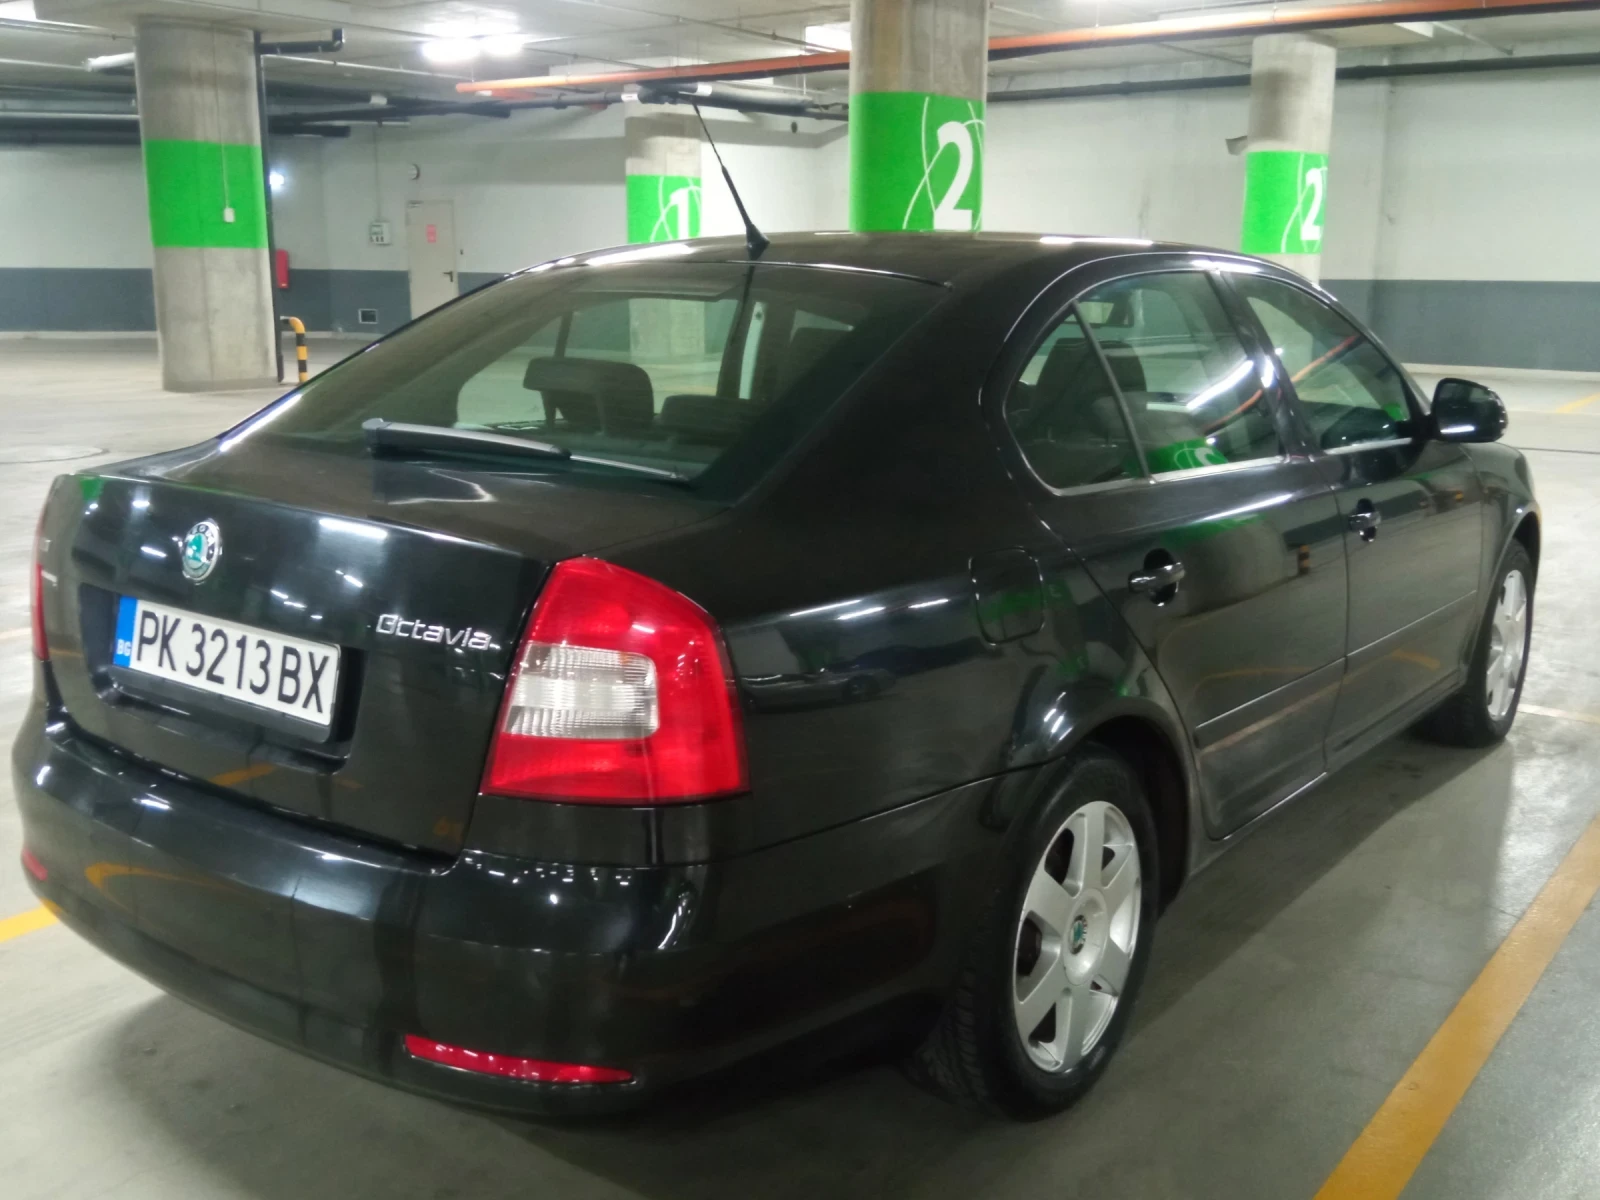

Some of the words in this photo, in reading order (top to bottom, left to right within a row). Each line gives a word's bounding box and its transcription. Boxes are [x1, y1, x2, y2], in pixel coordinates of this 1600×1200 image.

[936, 121, 973, 230] 2
[669, 187, 689, 240] 1
[1301, 168, 1322, 240] 2
[117, 639, 132, 656] BG
[375, 613, 492, 650] Octavia
